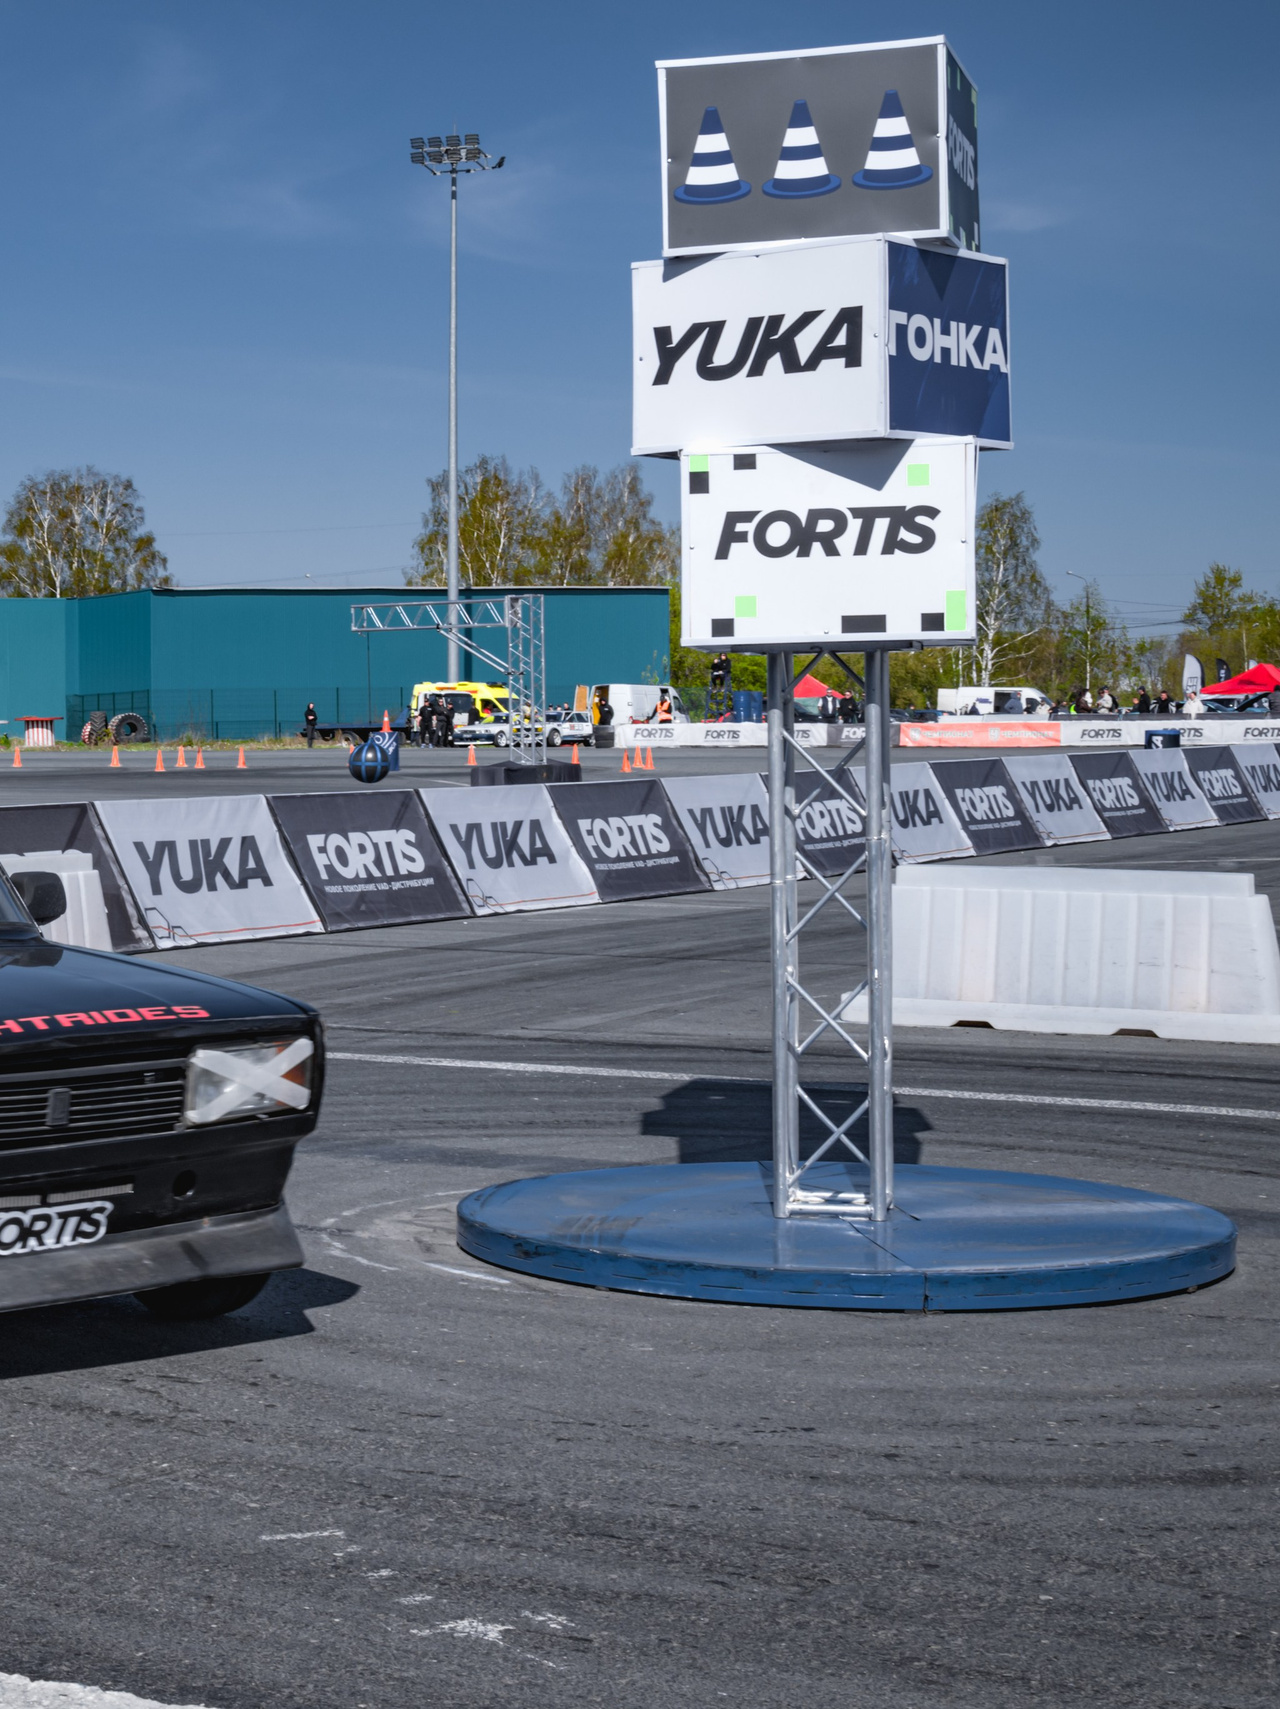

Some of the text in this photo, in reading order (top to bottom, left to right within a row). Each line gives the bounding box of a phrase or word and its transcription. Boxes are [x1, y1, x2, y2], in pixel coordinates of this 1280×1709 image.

[948, 113, 975, 191] FORTIS
[652, 305, 863, 386] YUKA
[888, 309, 1008, 374] ГОНКА
[714, 505, 941, 560] FORTIS
[634, 728, 675, 739] FORTIS
[704, 730, 741, 740] FORTIS
[841, 727, 866, 739] FOR
[1080, 728, 1122, 739] FORTIS
[1243, 727, 1280, 738] FORTI
[1020, 778, 1084, 814] YUKA
[1086, 777, 1140, 809] FORTIS
[1144, 771, 1196, 803] YUKA
[1198, 768, 1242, 799] FORTIS
[890, 788, 944, 829] UKA
[954, 785, 1015, 821] FORTIS
[448, 819, 558, 870] YUKA
[577, 813, 671, 859] FORTIS
[686, 804, 770, 849] YUKA
[132, 835, 274, 896] YUKA
[306, 829, 426, 880] FORTIS
